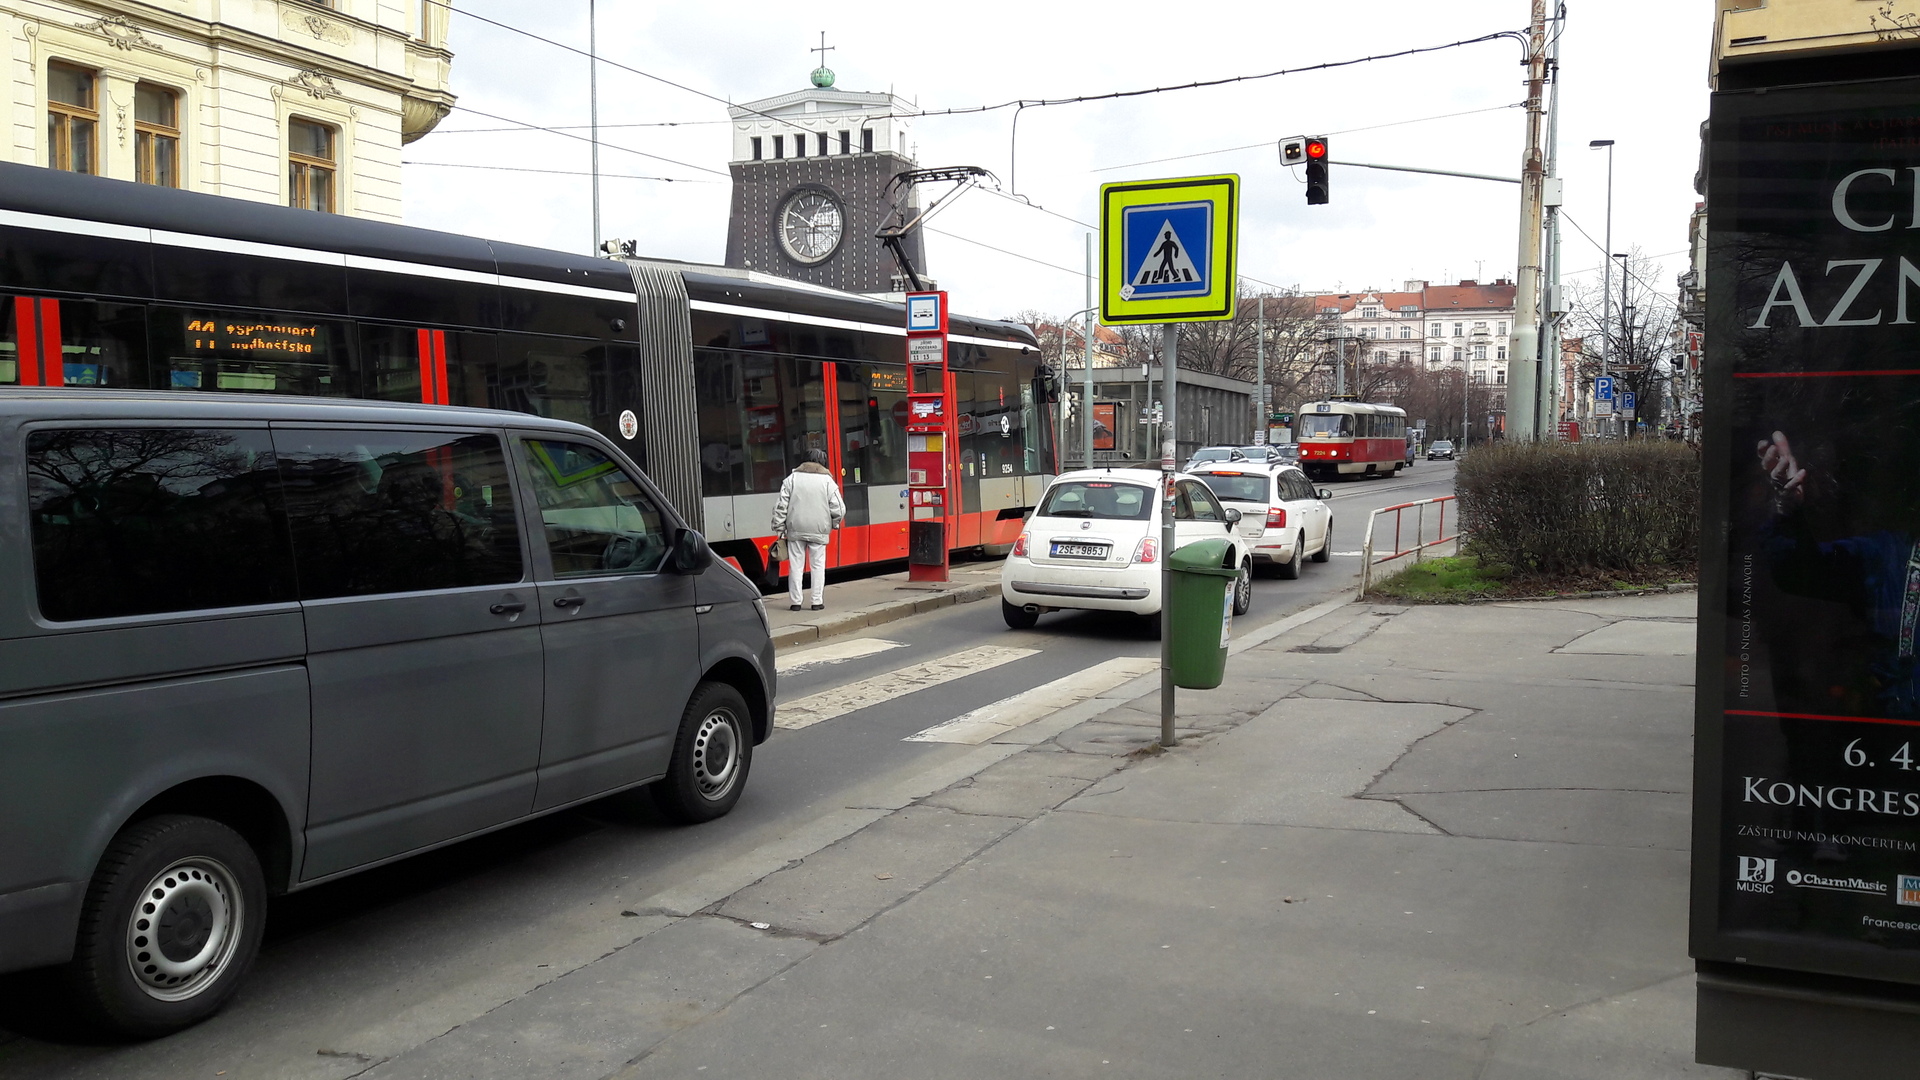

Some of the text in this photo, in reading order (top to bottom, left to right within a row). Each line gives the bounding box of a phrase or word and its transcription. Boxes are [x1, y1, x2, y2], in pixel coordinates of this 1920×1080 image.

[1832, 166, 1920, 232] C
[1598, 379, 1609, 393] P
[1624, 393, 1632, 404] P
[1058, 545, 1104, 556] 2SE 9853
[1743, 554, 1753, 606] AZNAVOUR
[1741, 609, 1751, 650] NICOLAS
[1740, 664, 1750, 697] PHOTO
[1844, 738, 1875, 767] 6.
[1797, 831, 1827, 843] NAD
[1832, 834, 1916, 852] KONCERTEM
[1737, 881, 1774, 894] MUSIC
[1803, 873, 1887, 892] CharmMusic
[1905, 879, 1920, 889] M
[1905, 890, 1920, 902] LI
